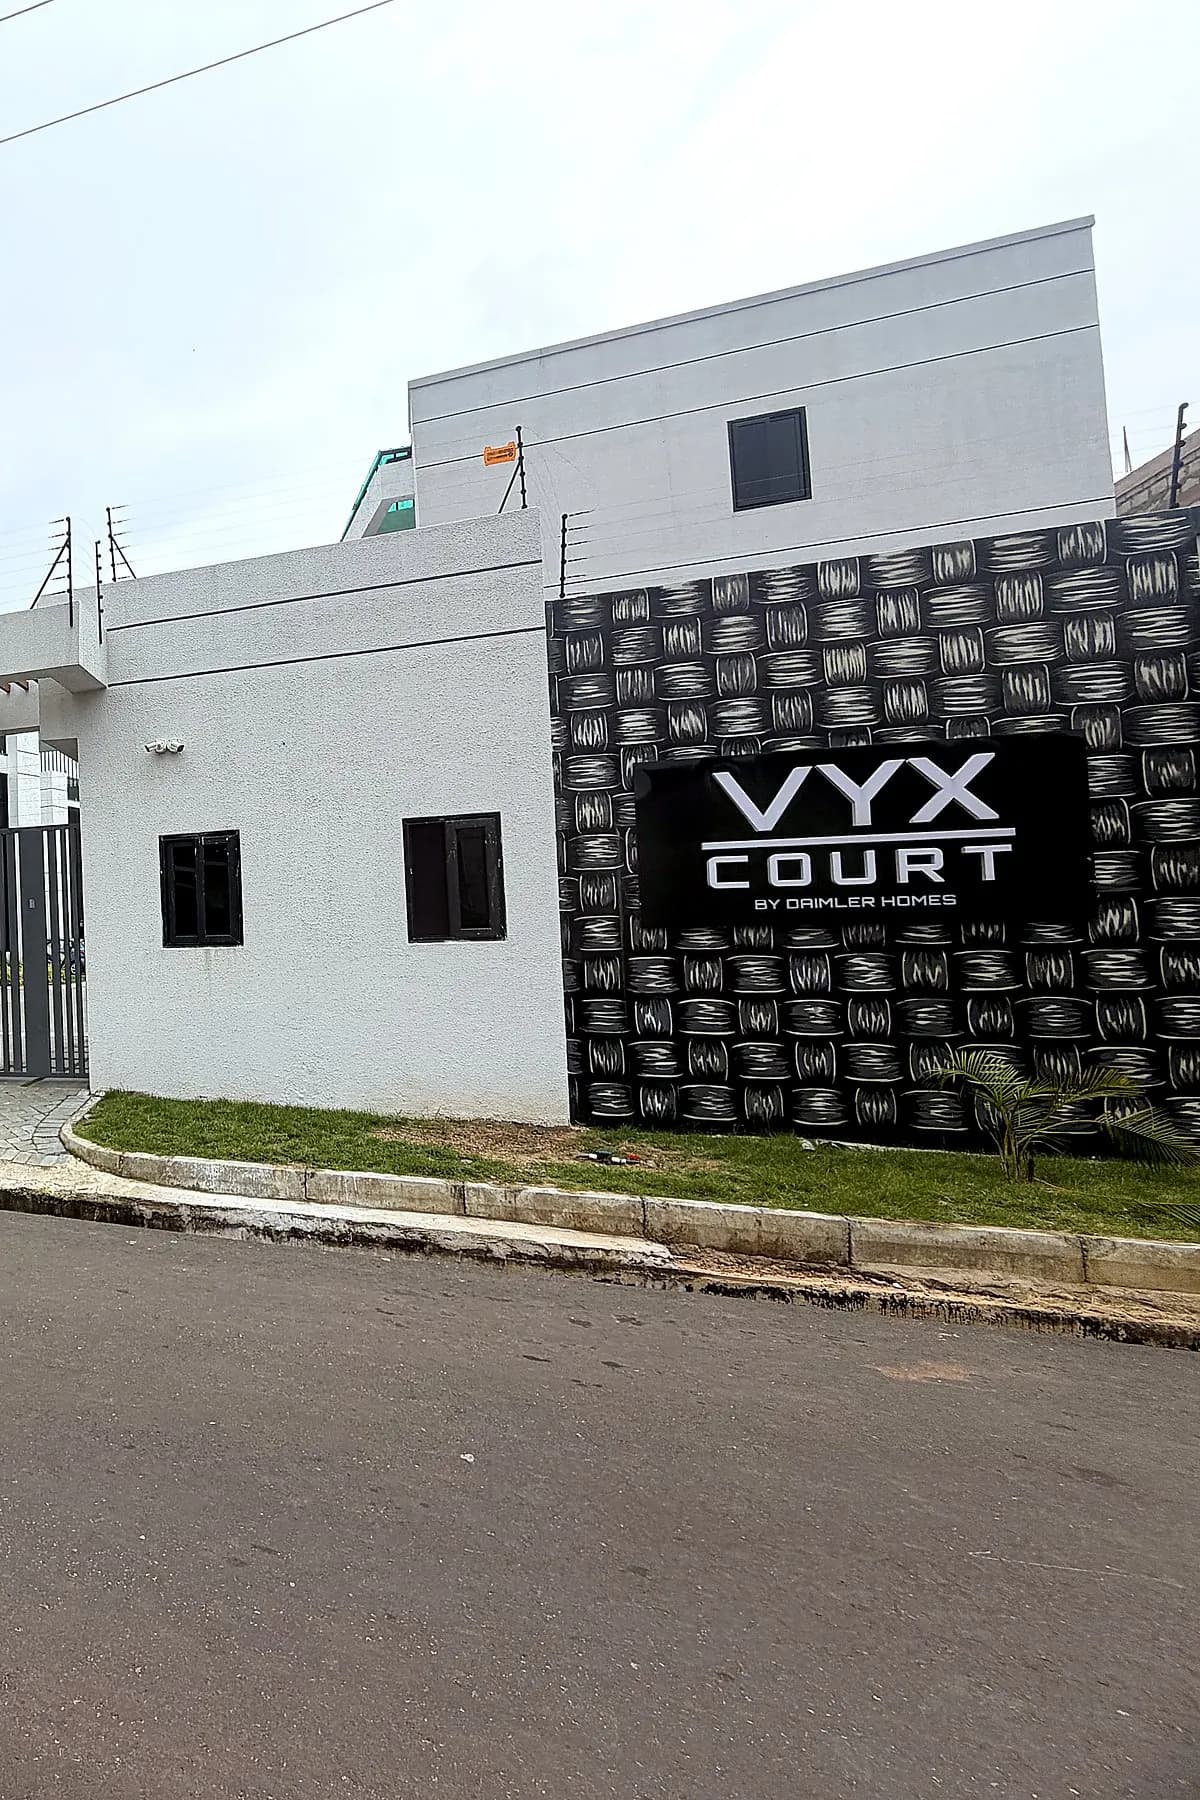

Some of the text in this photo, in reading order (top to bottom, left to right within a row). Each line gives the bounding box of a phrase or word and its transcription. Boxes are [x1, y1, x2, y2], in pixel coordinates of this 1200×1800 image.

[711, 752, 1000, 833] VYX
[706, 843, 1013, 889] COURT
[754, 894, 957, 910] BY DAIMLER HOMES
